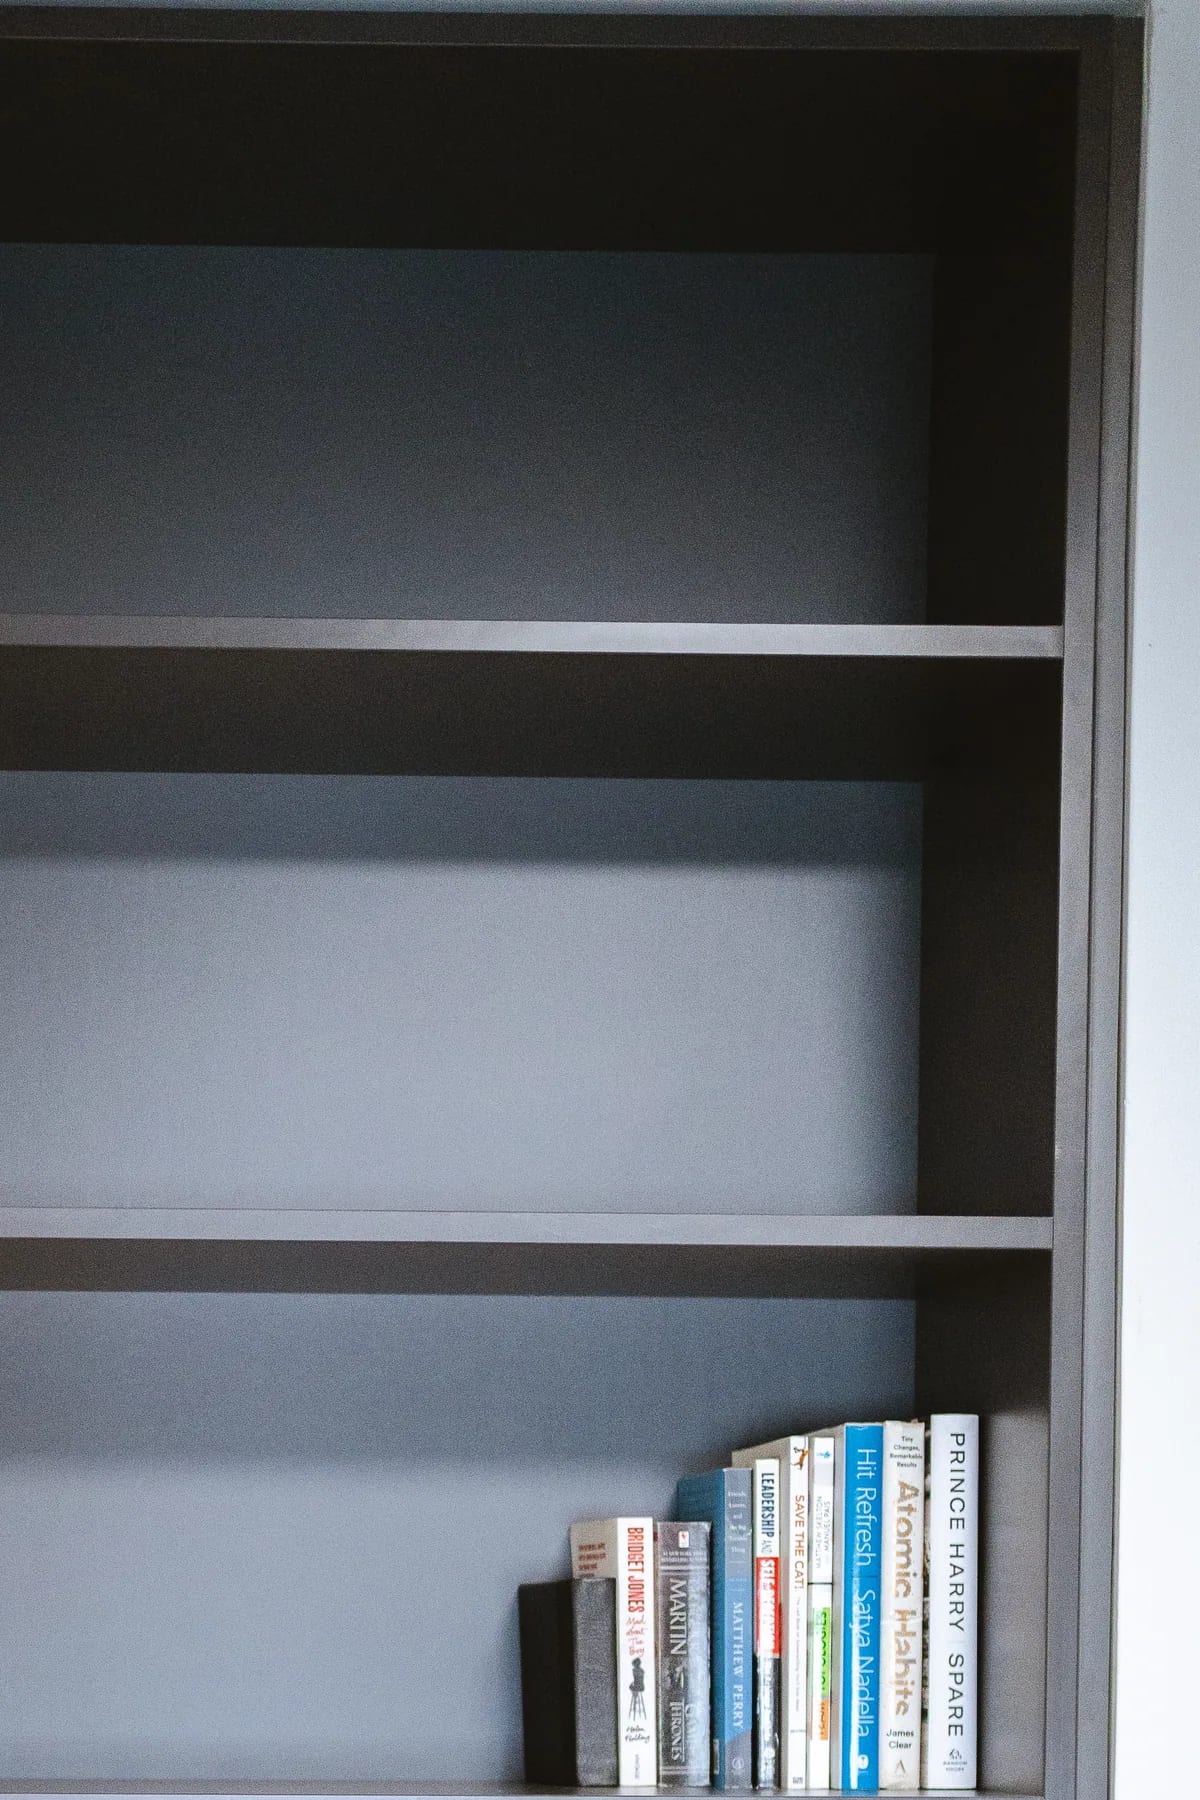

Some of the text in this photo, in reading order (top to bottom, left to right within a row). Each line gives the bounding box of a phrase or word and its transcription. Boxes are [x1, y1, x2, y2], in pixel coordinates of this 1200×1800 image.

[760, 1472, 774, 1537] LEADERSHIP
[793, 1494, 804, 1527] SAVE
[626, 1527, 644, 1612] BRIDGET JONES
[794, 1531, 804, 1556] THE
[794, 1560, 804, 1588] CAT!
[668, 1578, 687, 1654] MARTIN
[849, 1448, 877, 1736] Hit Refresh Satya Nadella
[891, 1479, 920, 1716] Atomic Habits
[947, 1432, 966, 1737] PRINCE HARRY SPARE
[732, 1601, 743, 1728] MATTHEW PERRY
[887, 1729, 914, 1737] James
[889, 1741, 912, 1749] Clear
